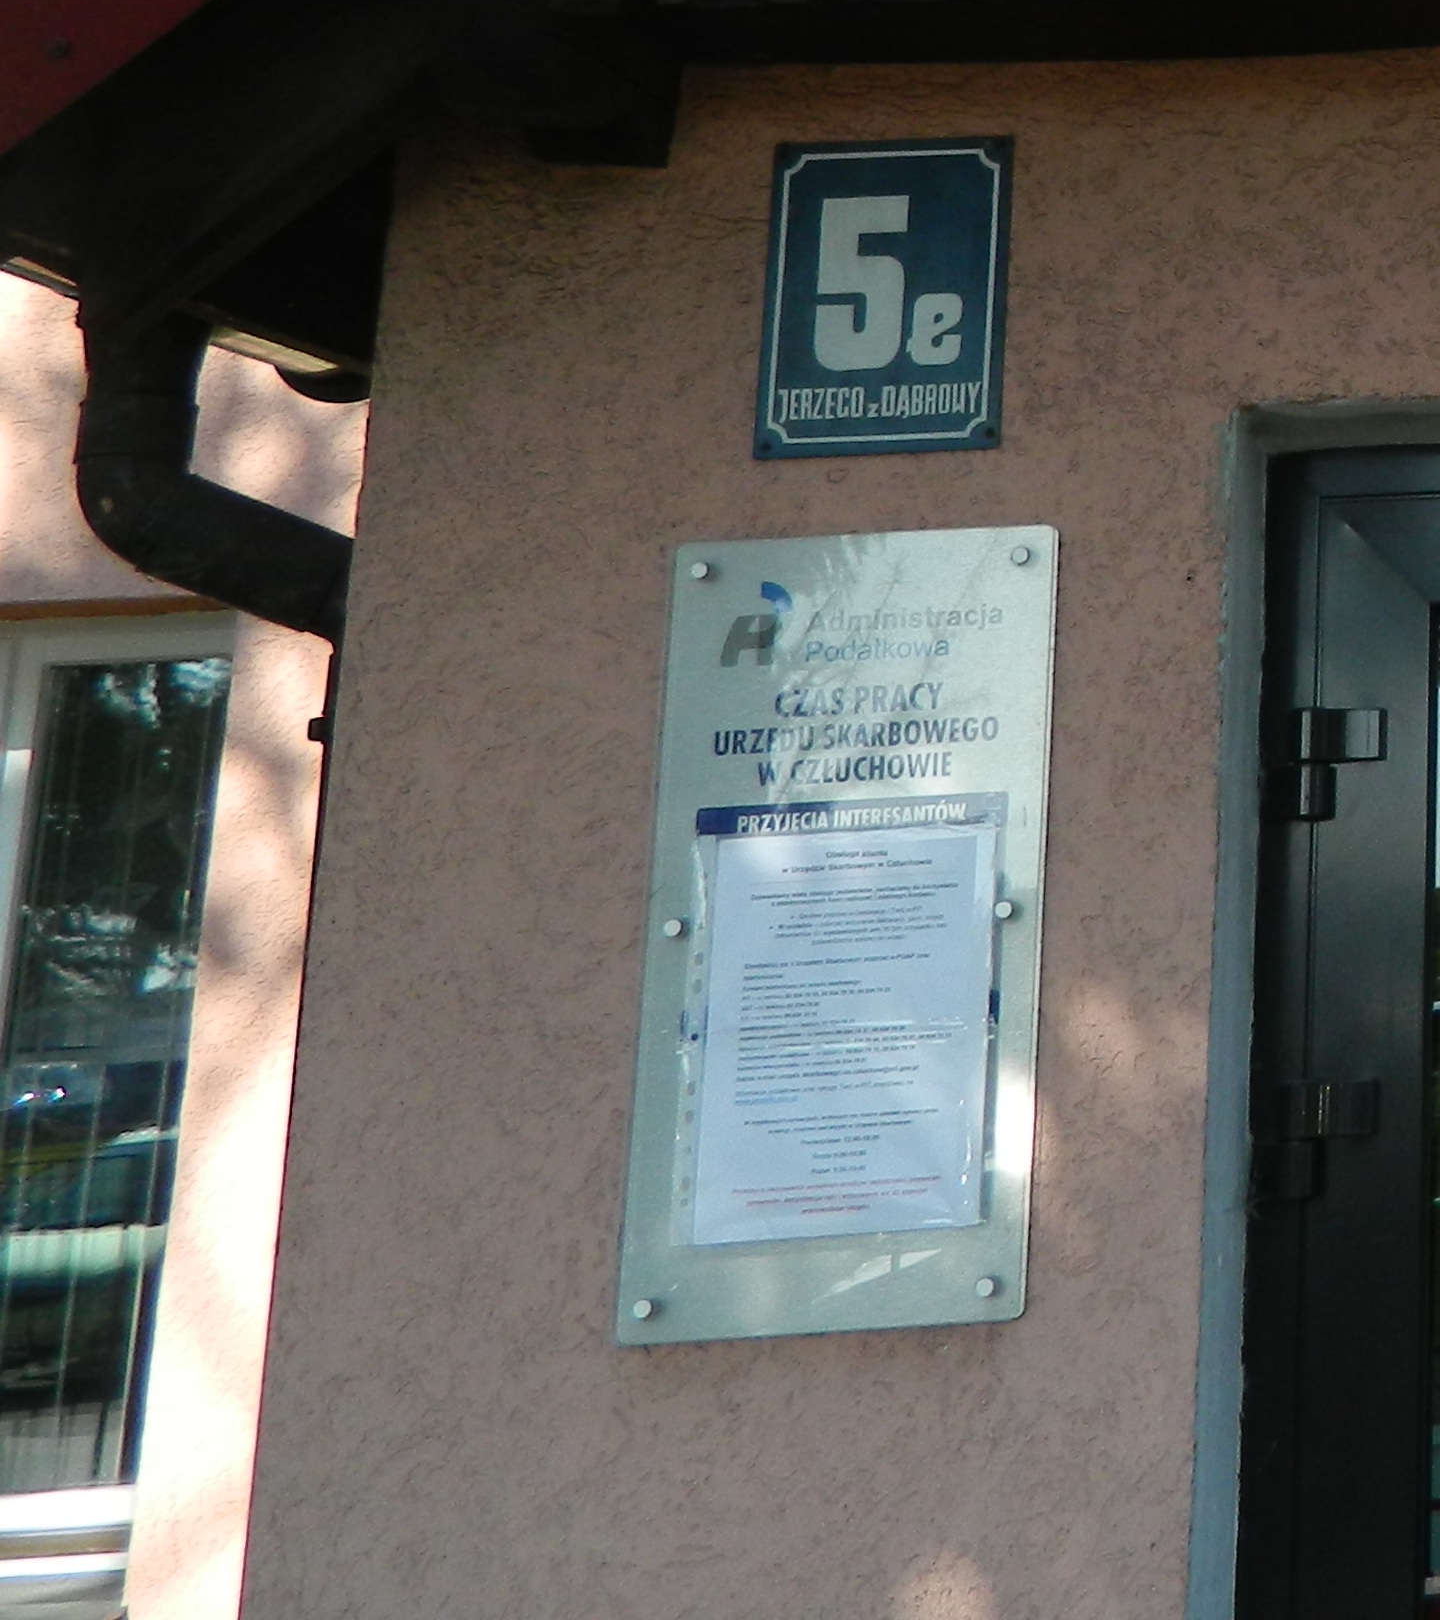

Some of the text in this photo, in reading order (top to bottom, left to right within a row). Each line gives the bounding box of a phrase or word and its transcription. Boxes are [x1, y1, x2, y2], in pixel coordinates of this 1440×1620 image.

[881, 382, 981, 419] DĄBROWY
[807, 604, 1002, 632] Administracja
[805, 636, 949, 662] Podatkowa
[775, 682, 944, 718] CZAS PRACY
[823, 716, 998, 750] SKARBOWEGO
[790, 752, 952, 785] CZŁUCHOWIE
[833, 799, 967, 828] INTERESANTÓW
